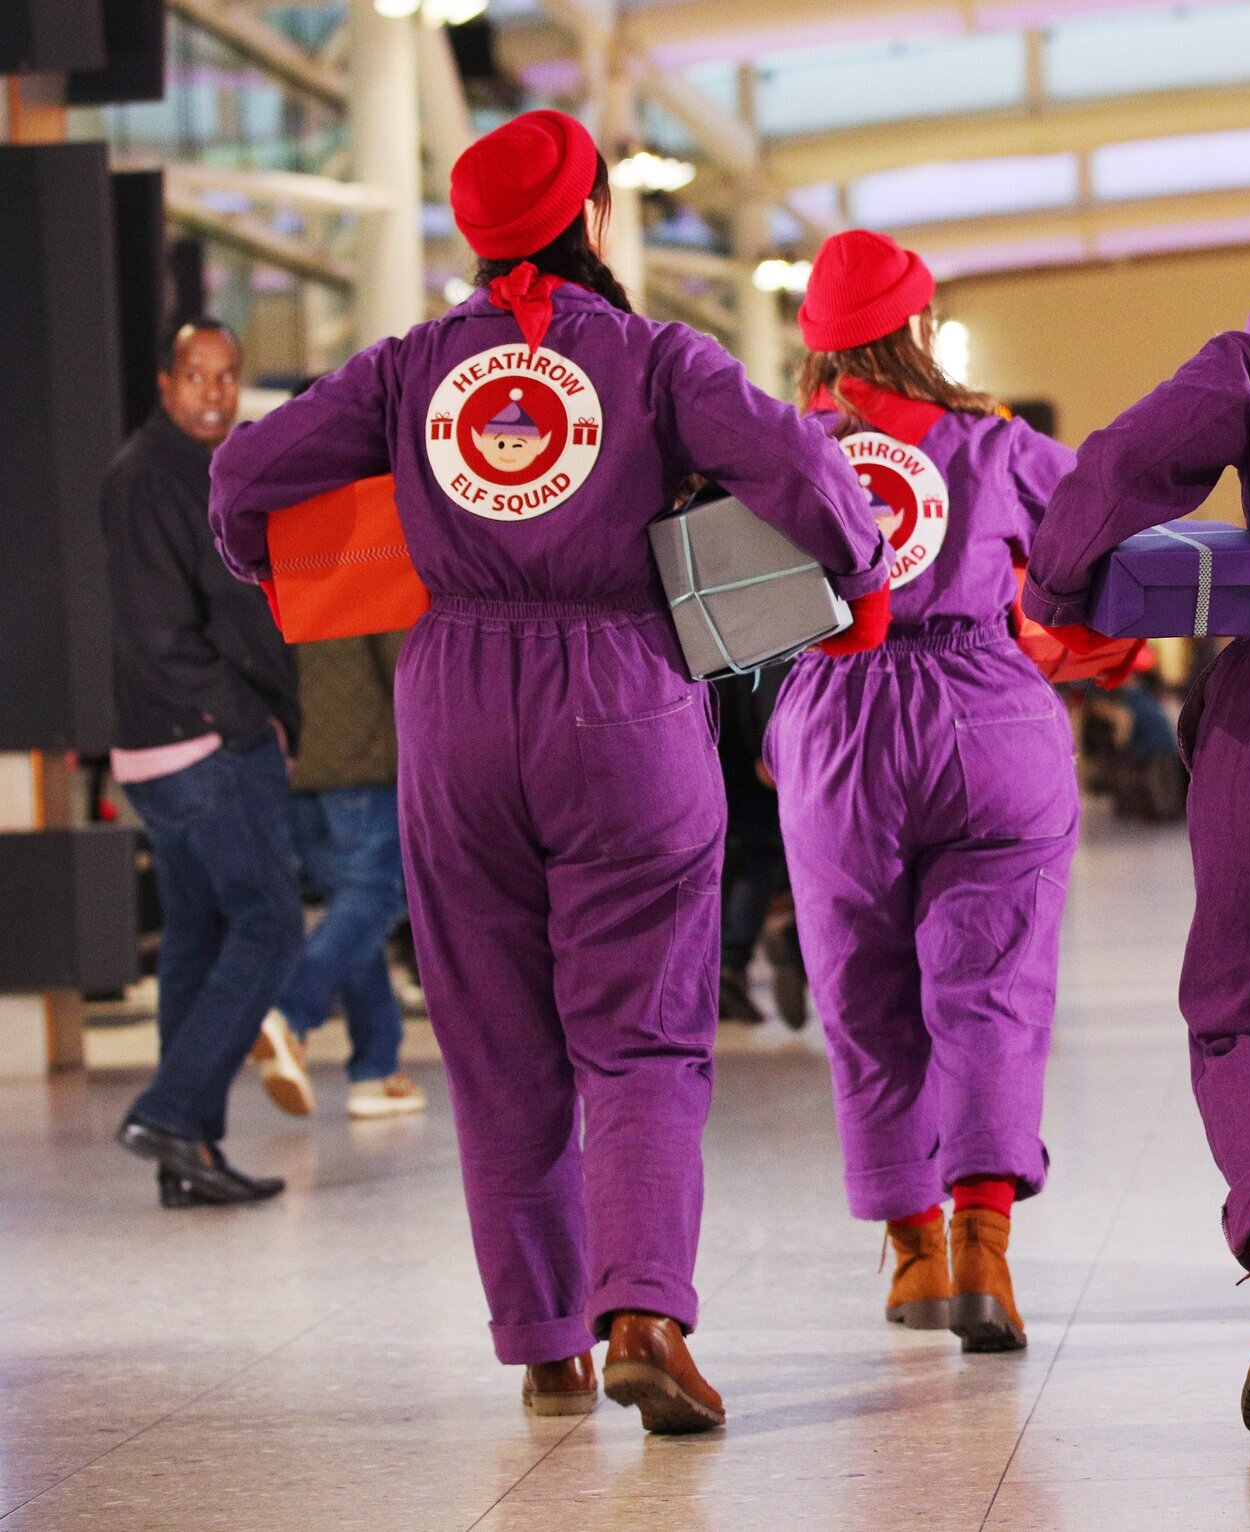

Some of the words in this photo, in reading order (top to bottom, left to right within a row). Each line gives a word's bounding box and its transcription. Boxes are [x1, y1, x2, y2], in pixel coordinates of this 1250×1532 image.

[452, 352, 585, 397] HEATHROW
[845, 441, 926, 477] THROW
[450, 472, 488, 505] ELF
[492, 472, 571, 515] SQUAD
[889, 544, 927, 579] UAD
